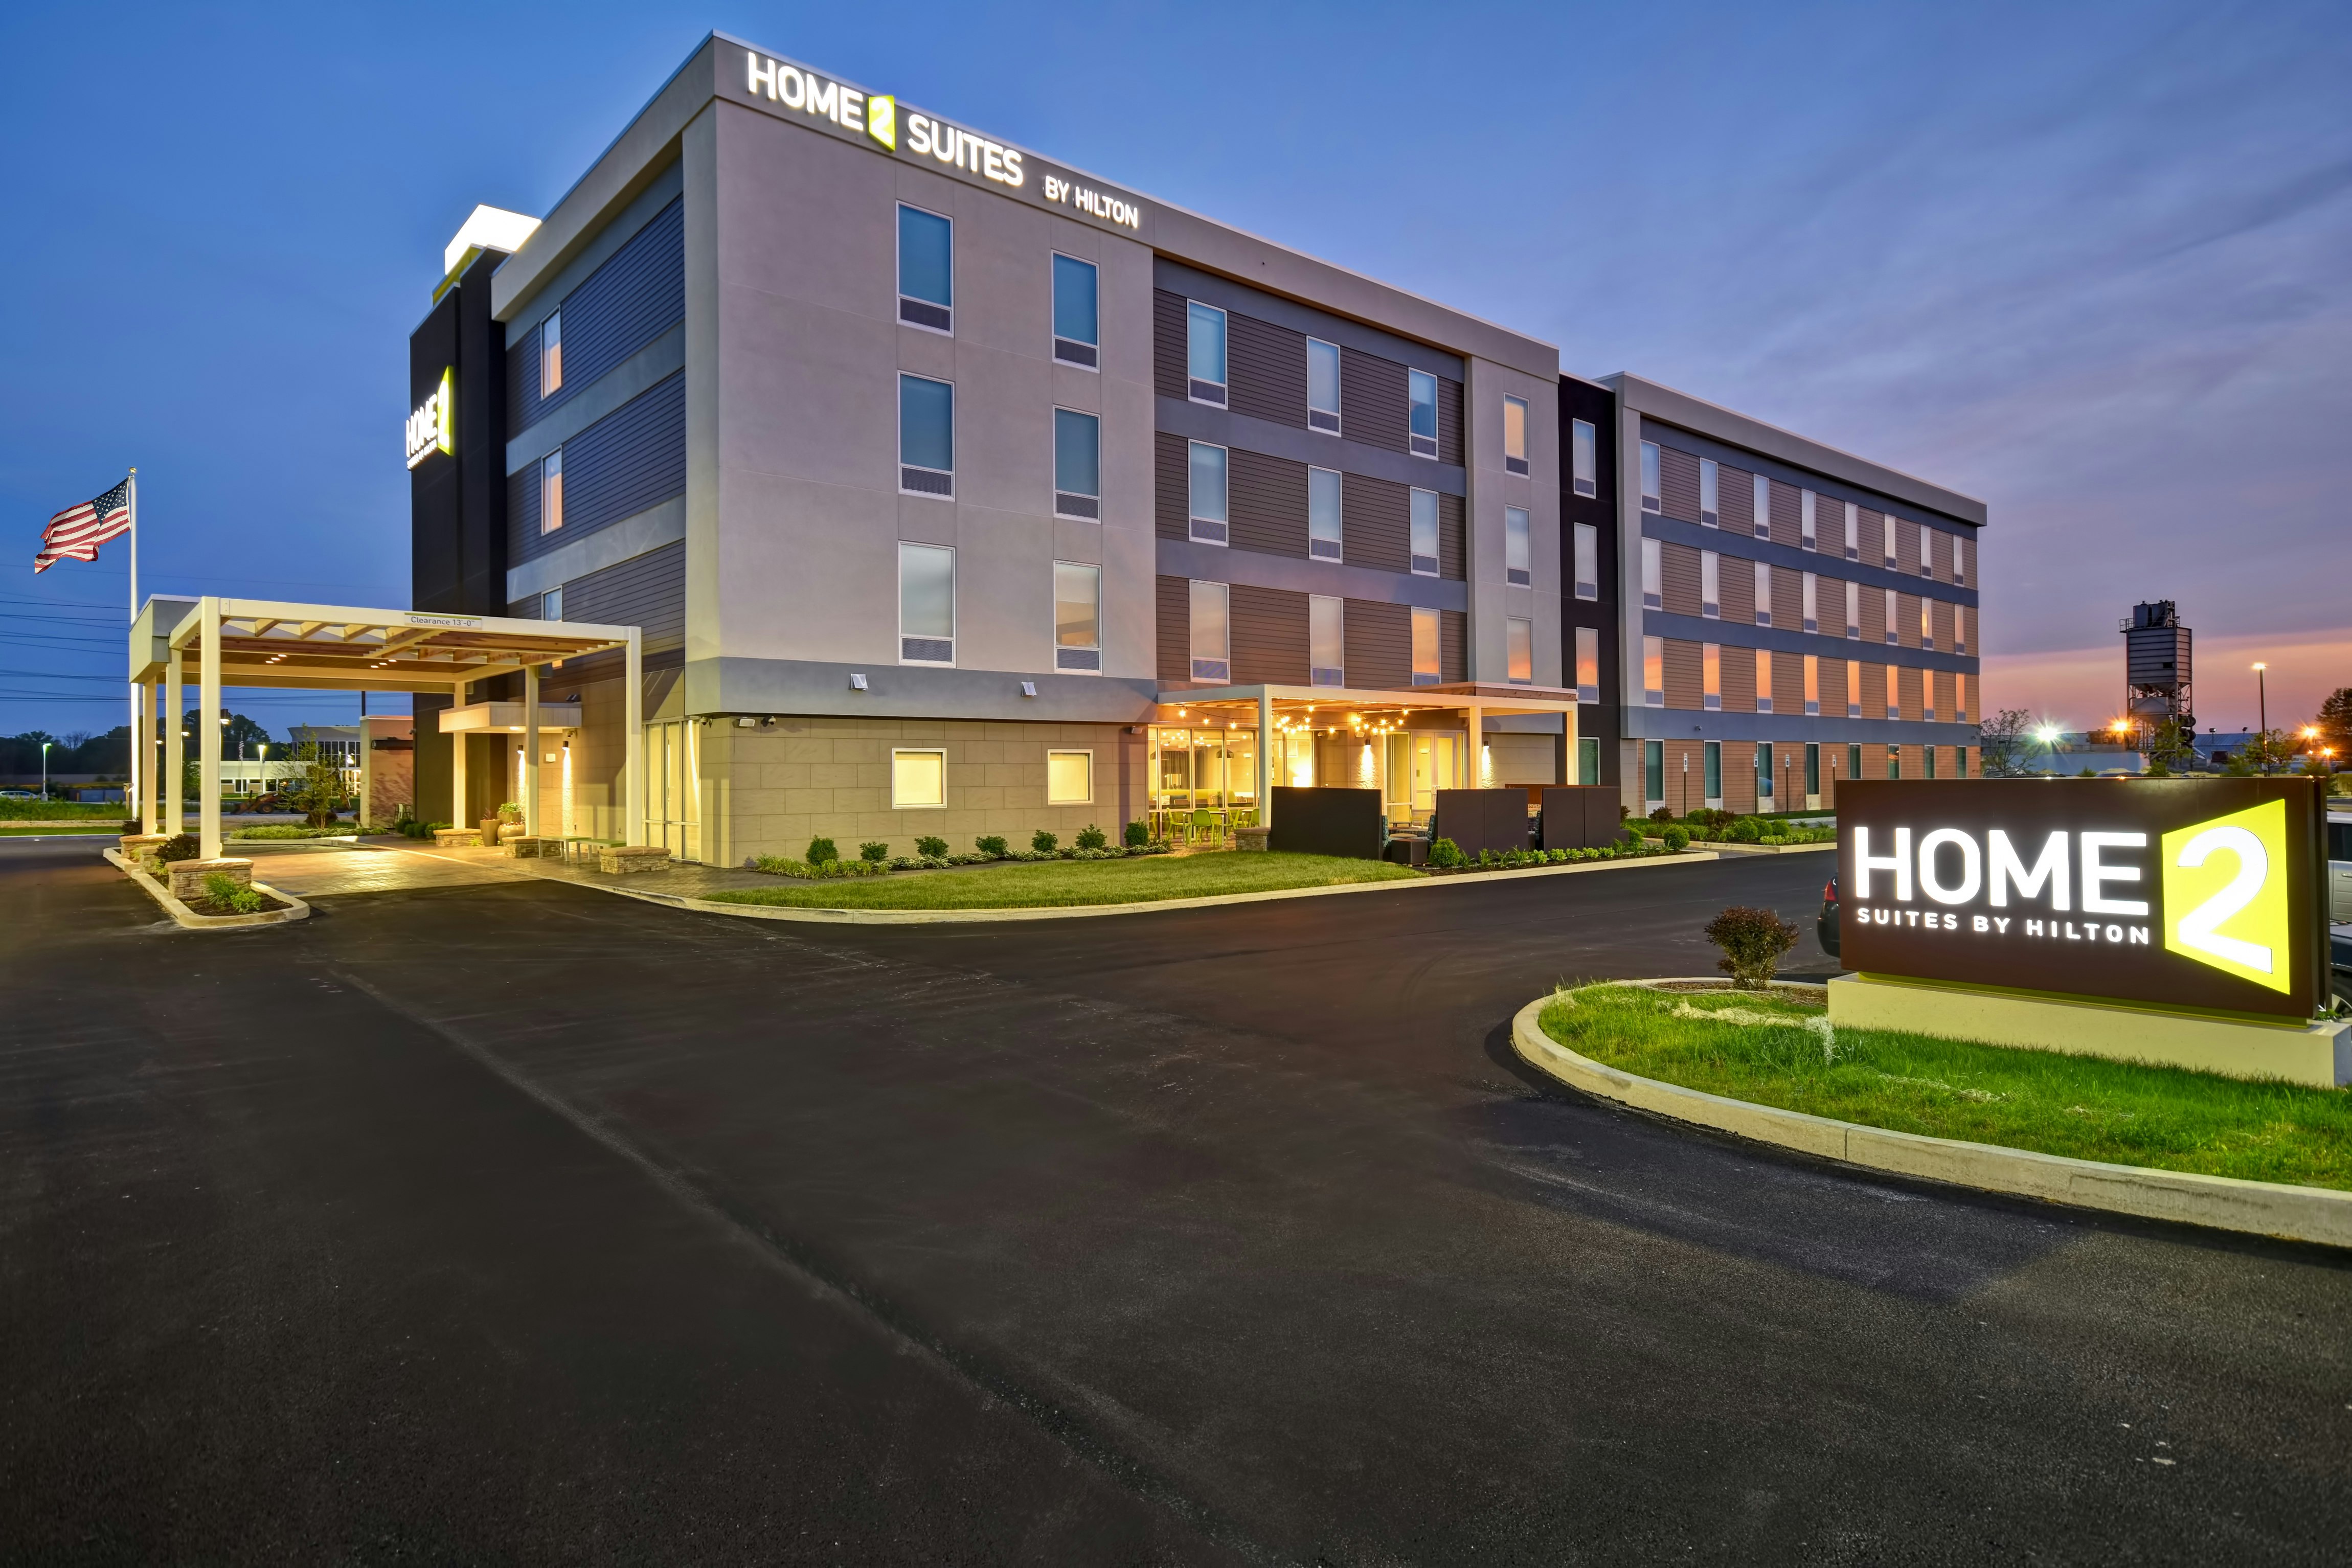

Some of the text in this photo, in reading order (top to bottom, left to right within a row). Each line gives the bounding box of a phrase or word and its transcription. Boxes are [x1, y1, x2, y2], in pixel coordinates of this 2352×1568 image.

[748, 52, 1138, 229] HOME 2 SUITES BY HILTON
[406, 393, 437, 458] HOME
[411, 616, 450, 626] Clearance
[1854, 826, 2273, 974] HOME 2
[1857, 907, 2149, 945] SUITES BY HILTON
